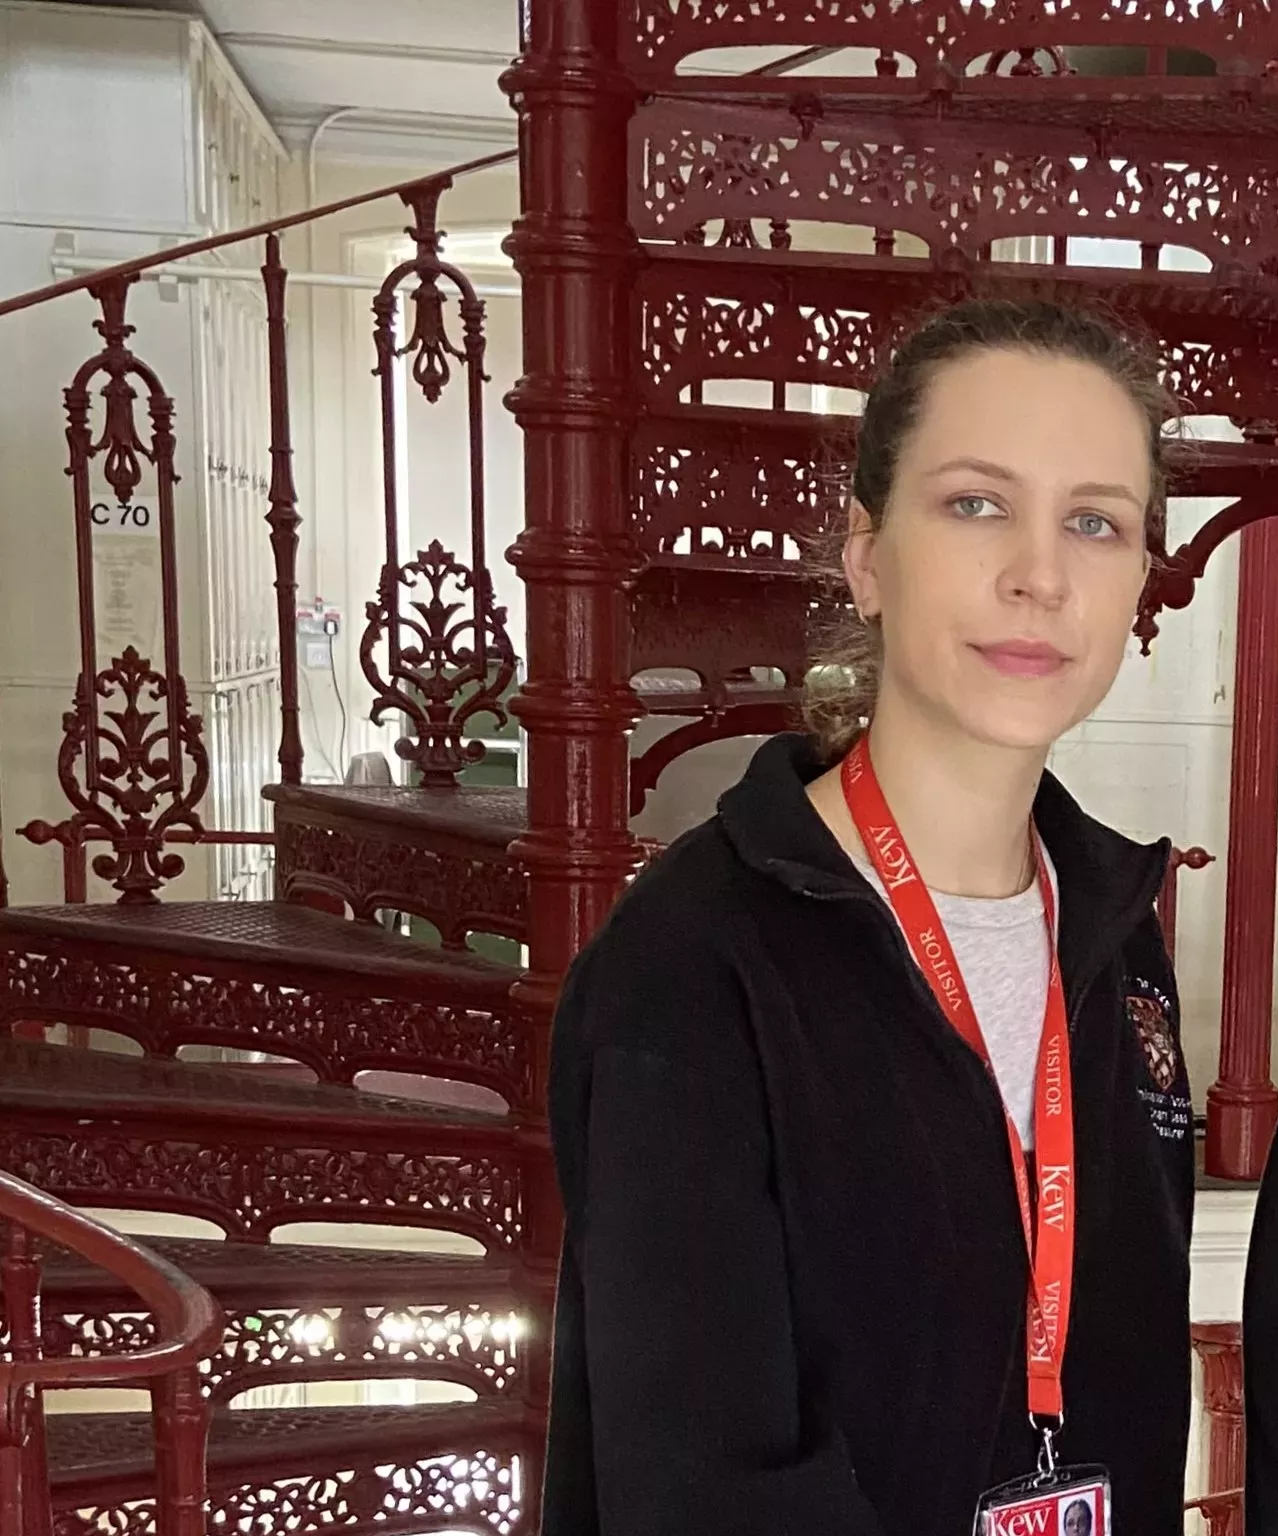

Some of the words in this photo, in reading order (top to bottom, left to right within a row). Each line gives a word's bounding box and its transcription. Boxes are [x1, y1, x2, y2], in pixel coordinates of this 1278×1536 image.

[91, 503, 110, 525] C
[117, 504, 150, 527] 70
[868, 825, 917, 891] Kew
[920, 926, 962, 1012] VISITOR
[1044, 1033, 1062, 1118] VISITOR
[1041, 1162, 1071, 1234] Kew
